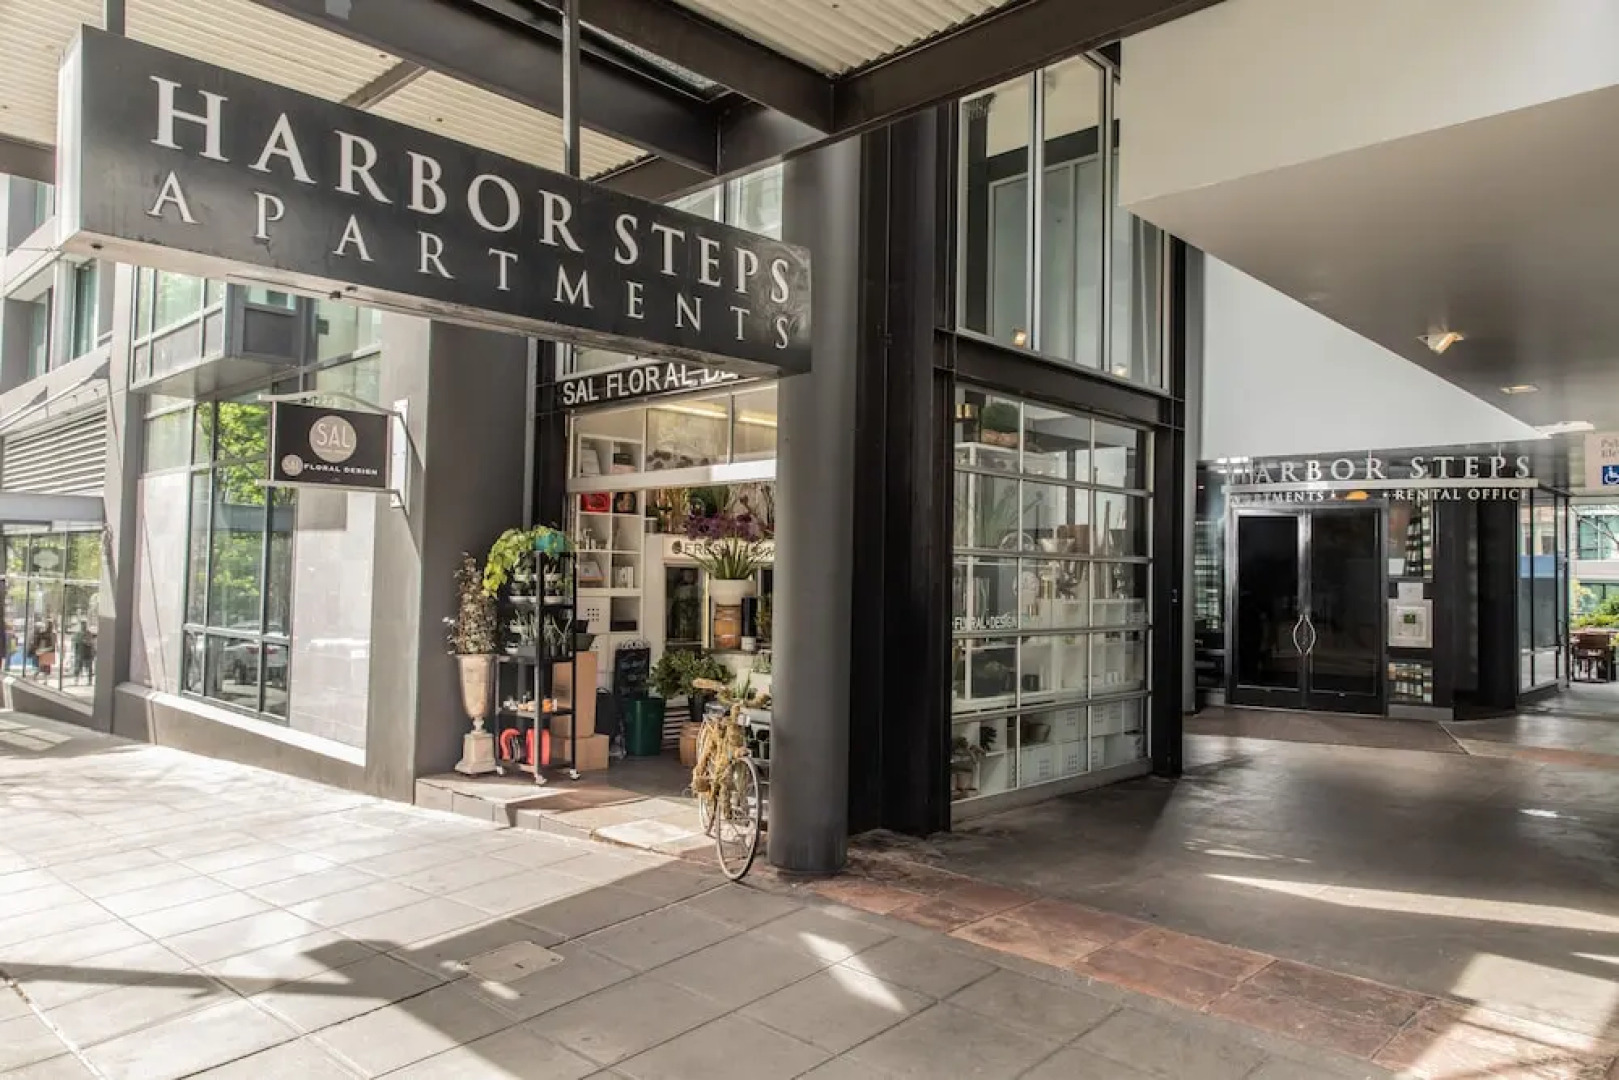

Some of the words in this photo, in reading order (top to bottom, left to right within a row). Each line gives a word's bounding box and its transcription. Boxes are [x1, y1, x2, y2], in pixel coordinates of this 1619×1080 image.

[150, 75, 584, 253] HARBOR
[614, 213, 789, 304] STEPS
[147, 170, 789, 349] APARTMENTS
[563, 377, 600, 406] SAL
[606, 362, 697, 399] FLORAL
[316, 423, 351, 448] SAL
[303, 464, 341, 473] FLORAL
[344, 466, 378, 476] DESIGN
[1409, 455, 1530, 479] STEPS
[1395, 488, 1461, 501] RENTAL
